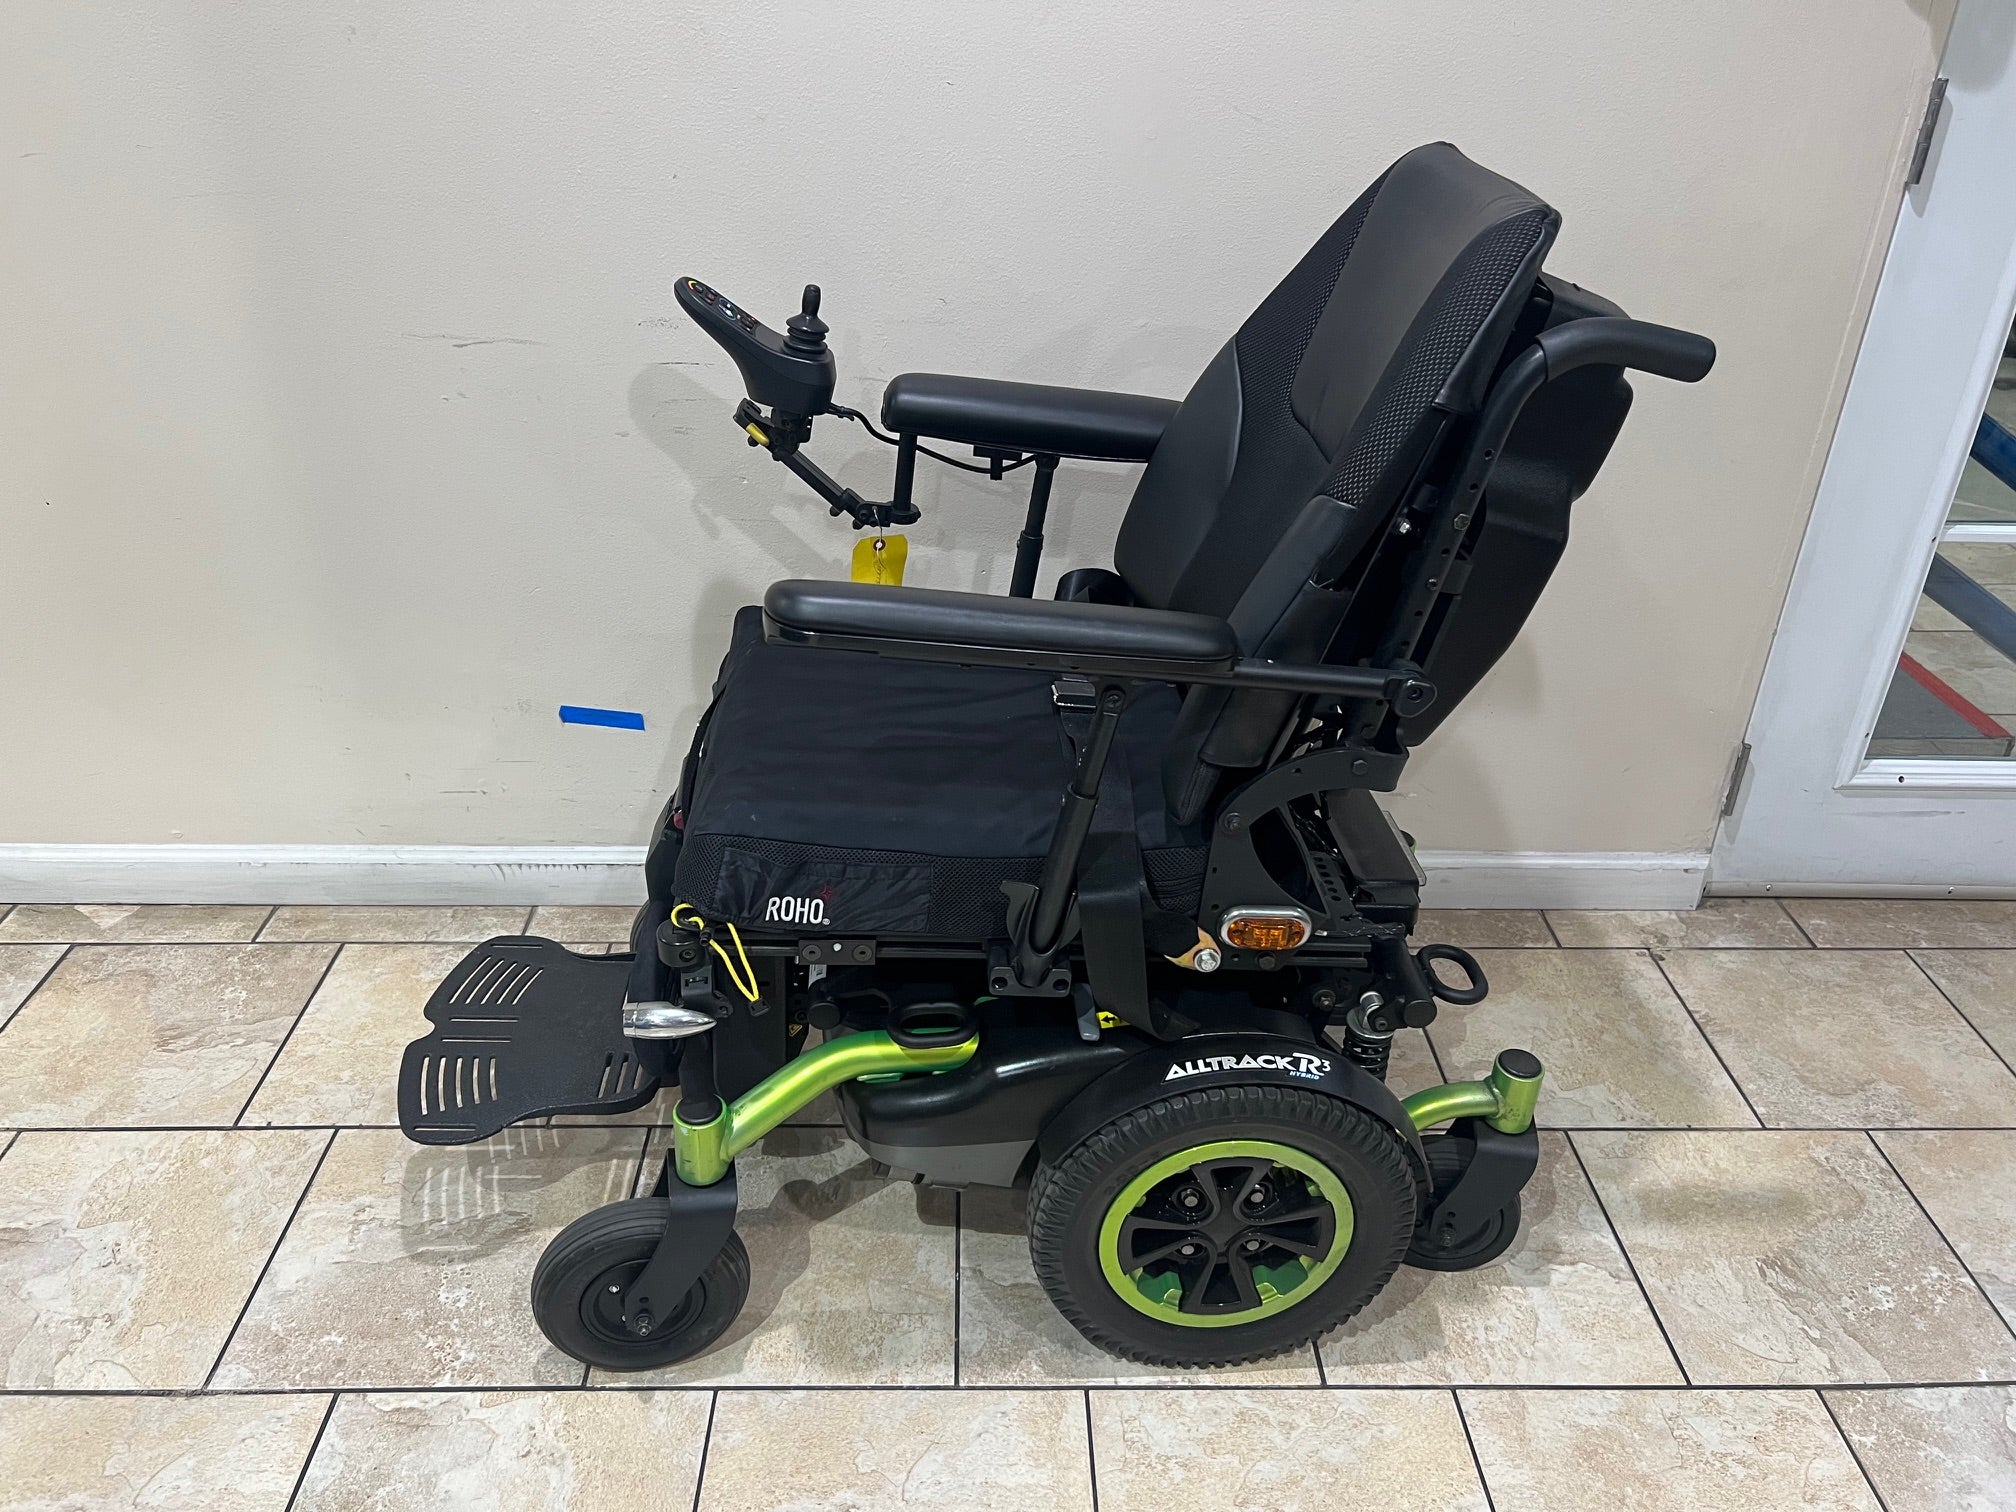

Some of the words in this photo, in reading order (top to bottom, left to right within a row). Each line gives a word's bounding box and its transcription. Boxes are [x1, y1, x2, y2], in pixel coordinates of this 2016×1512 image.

[765, 896, 824, 924] ROHO
[1165, 1054, 1297, 1081] ALLTRACK
[1289, 1070, 1320, 1080] HYBRID
